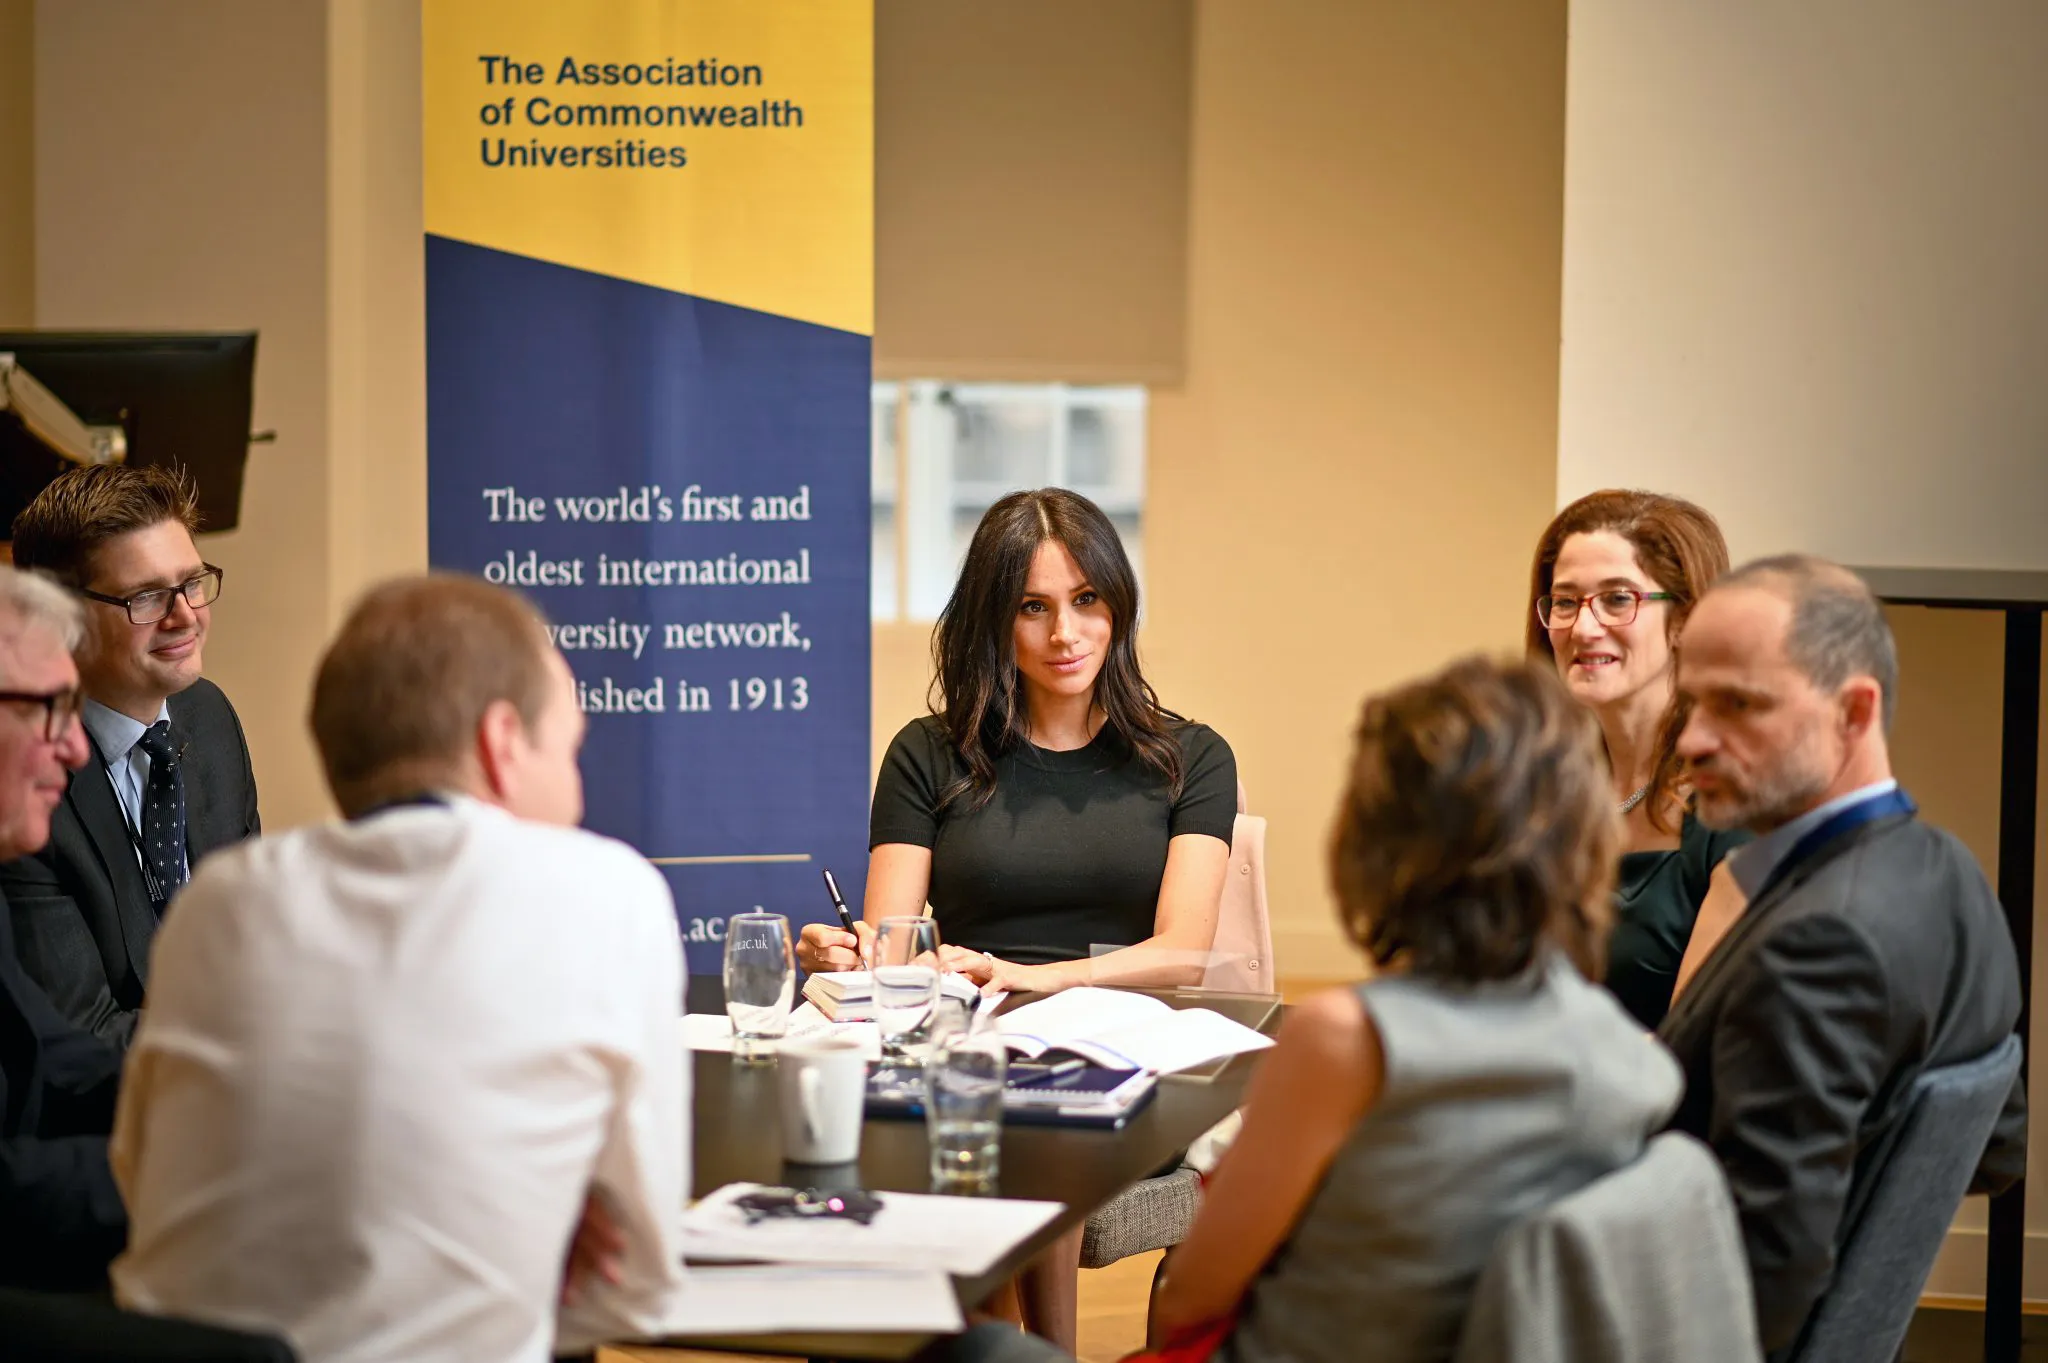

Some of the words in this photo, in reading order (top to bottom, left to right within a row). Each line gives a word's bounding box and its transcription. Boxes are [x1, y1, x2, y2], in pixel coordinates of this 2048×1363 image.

[478, 55, 545, 86] The
[555, 56, 763, 87] Association
[479, 97, 516, 127] of
[525, 97, 804, 128] Commonwealth
[480, 138, 688, 169] Universities
[483, 486, 546, 522] The
[681, 485, 742, 521] first
[751, 485, 812, 521] and
[483, 550, 584, 586] oldest
[598, 549, 811, 586] international
[543, 617, 651, 660] versity
[663, 611, 812, 652] network,
[571, 676, 666, 713] lished
[678, 679, 711, 712] in
[729, 676, 810, 711] 1913
